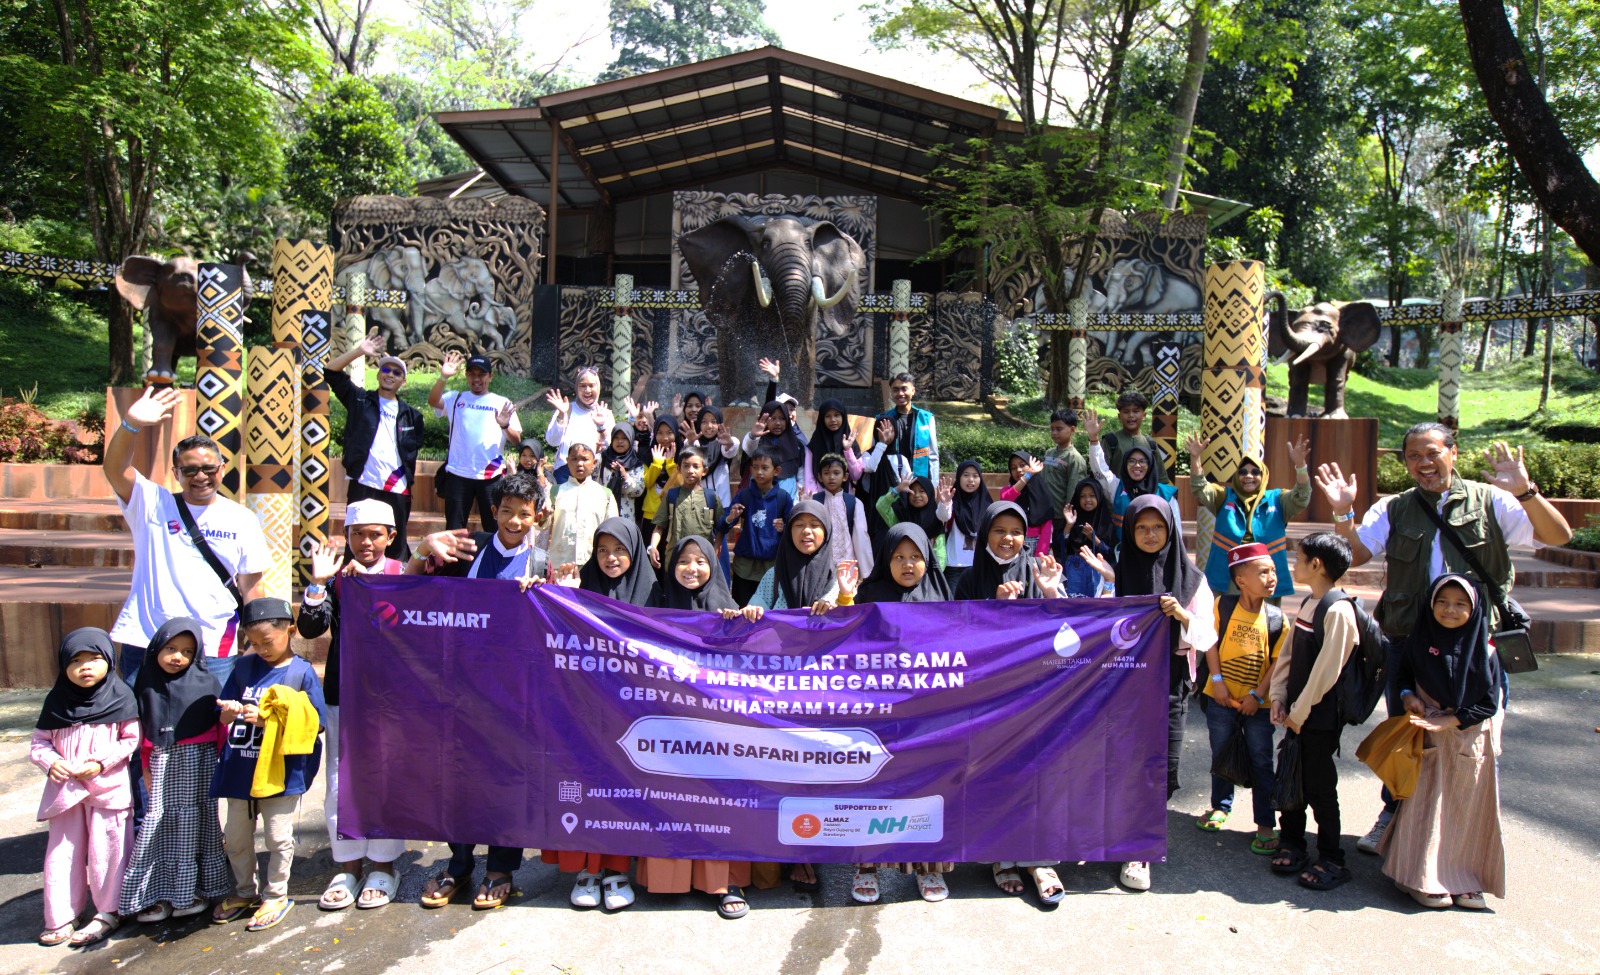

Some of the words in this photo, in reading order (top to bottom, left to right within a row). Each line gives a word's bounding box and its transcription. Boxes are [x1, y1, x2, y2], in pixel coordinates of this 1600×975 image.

[183, 528, 237, 540] SMART
[402, 609, 491, 628] XLSMART
[546, 633, 639, 658] MAJELIS
[740, 654, 848, 671] XLSMART
[855, 651, 968, 670] BERSAMA
[554, 653, 638, 675] REGION
[644, 664, 700, 684] EAST
[706, 671, 964, 691] MENYELENGGARAKAN
[619, 686, 697, 707] GEBYAR
[702, 697, 822, 715] MUHARRAM
[827, 702, 875, 715] 1447
[879, 703, 893, 715] H
[240, 749, 259, 759] VARSIT
[637, 738, 656, 753] DI
[660, 739, 730, 756] TAMAN
[733, 743, 799, 763] SAFARI
[803, 750, 871, 764] PRIGEN
[586, 788, 612, 798] JULI
[614, 788, 642, 798] 2025
[650, 790, 719, 806] MUHARRAM
[720, 797, 748, 808] 1447
[750, 798, 758, 808] H
[584, 820, 653, 832] PASURUAN,
[656, 822, 692, 832] JAWA
[694, 823, 731, 834] TIMUR
[868, 816, 908, 834] NH
